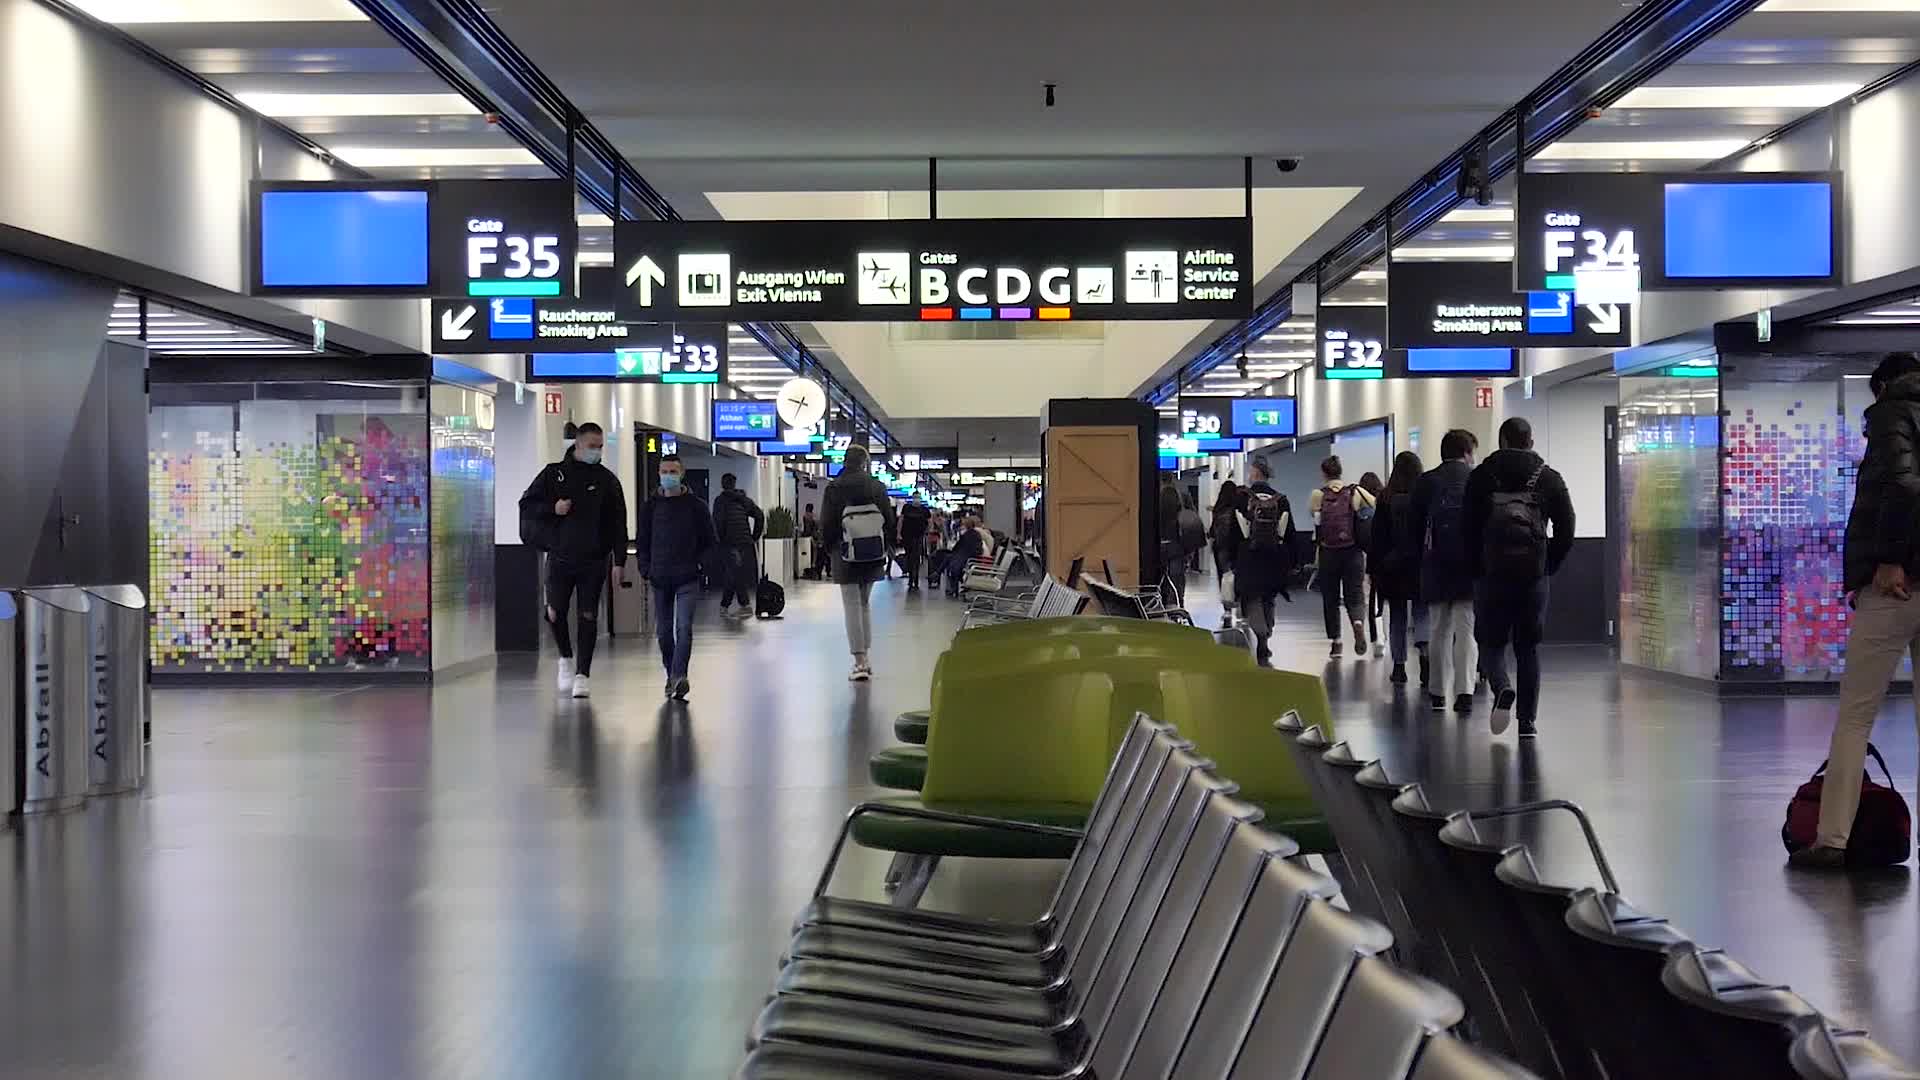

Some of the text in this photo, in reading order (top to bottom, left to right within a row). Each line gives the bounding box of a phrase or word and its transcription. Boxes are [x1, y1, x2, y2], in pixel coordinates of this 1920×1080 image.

[467, 219, 503, 233] Gate
[1544, 213, 1581, 226] Gate
[920, 252, 958, 265] Gates
[1184, 249, 1234, 265] Airline
[736, 269, 845, 288] Ausgang Wien
[1184, 267, 1239, 283] Service
[920, 267, 1071, 305] B C D G
[1184, 286, 1237, 300] Center
[737, 287, 822, 303] Exit Vienna
[538, 309, 616, 323] Raucherzon
[1437, 304, 1523, 318] Raucherzone
[538, 324, 629, 340] Smoking Area
[1432, 318, 1523, 335] Smoking Area
[94, 654, 109, 762] Abfall
[35, 663, 50, 777] Abfall
